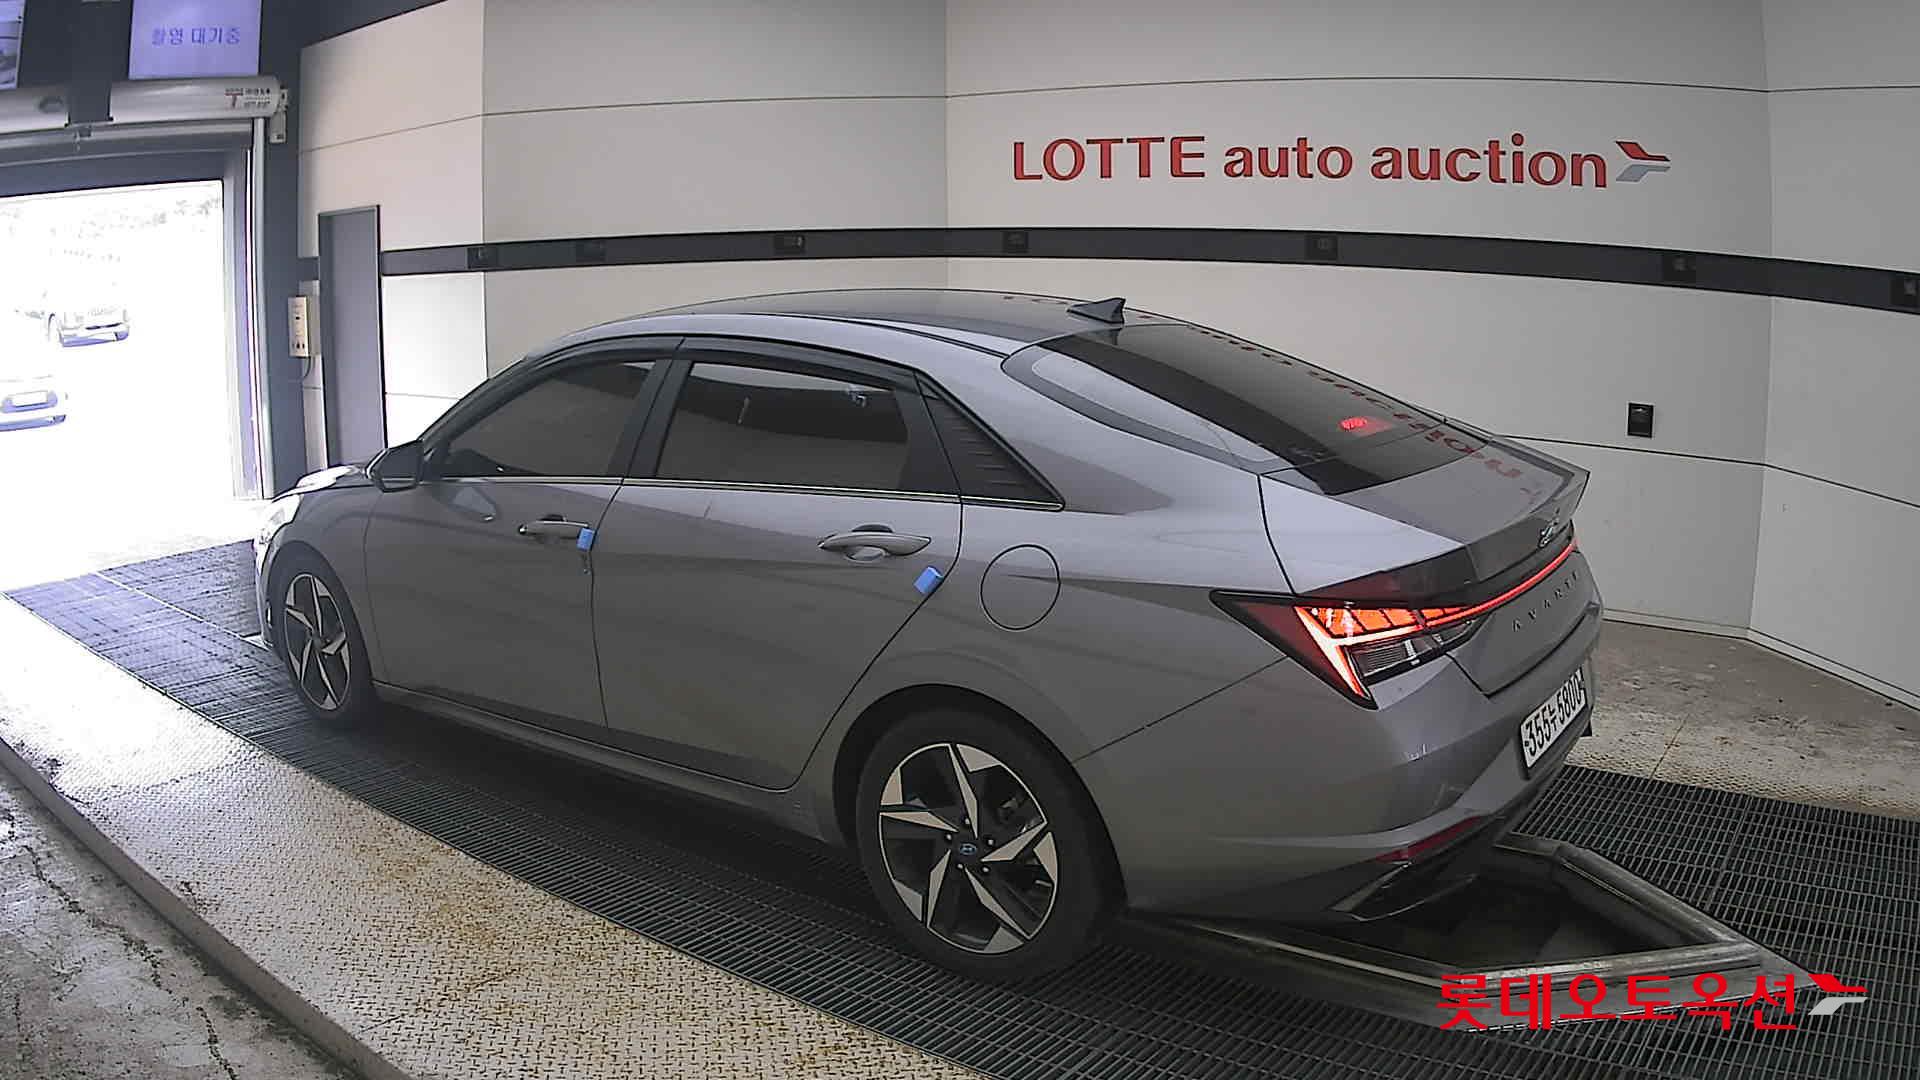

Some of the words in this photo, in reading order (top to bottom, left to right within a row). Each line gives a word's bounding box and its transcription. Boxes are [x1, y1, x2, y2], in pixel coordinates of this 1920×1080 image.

[191, 26, 240, 46] 대기중
[1013, 136, 1206, 181] LOTTE
[1223, 136, 1353, 180] auto
[1369, 132, 1608, 188] auction
